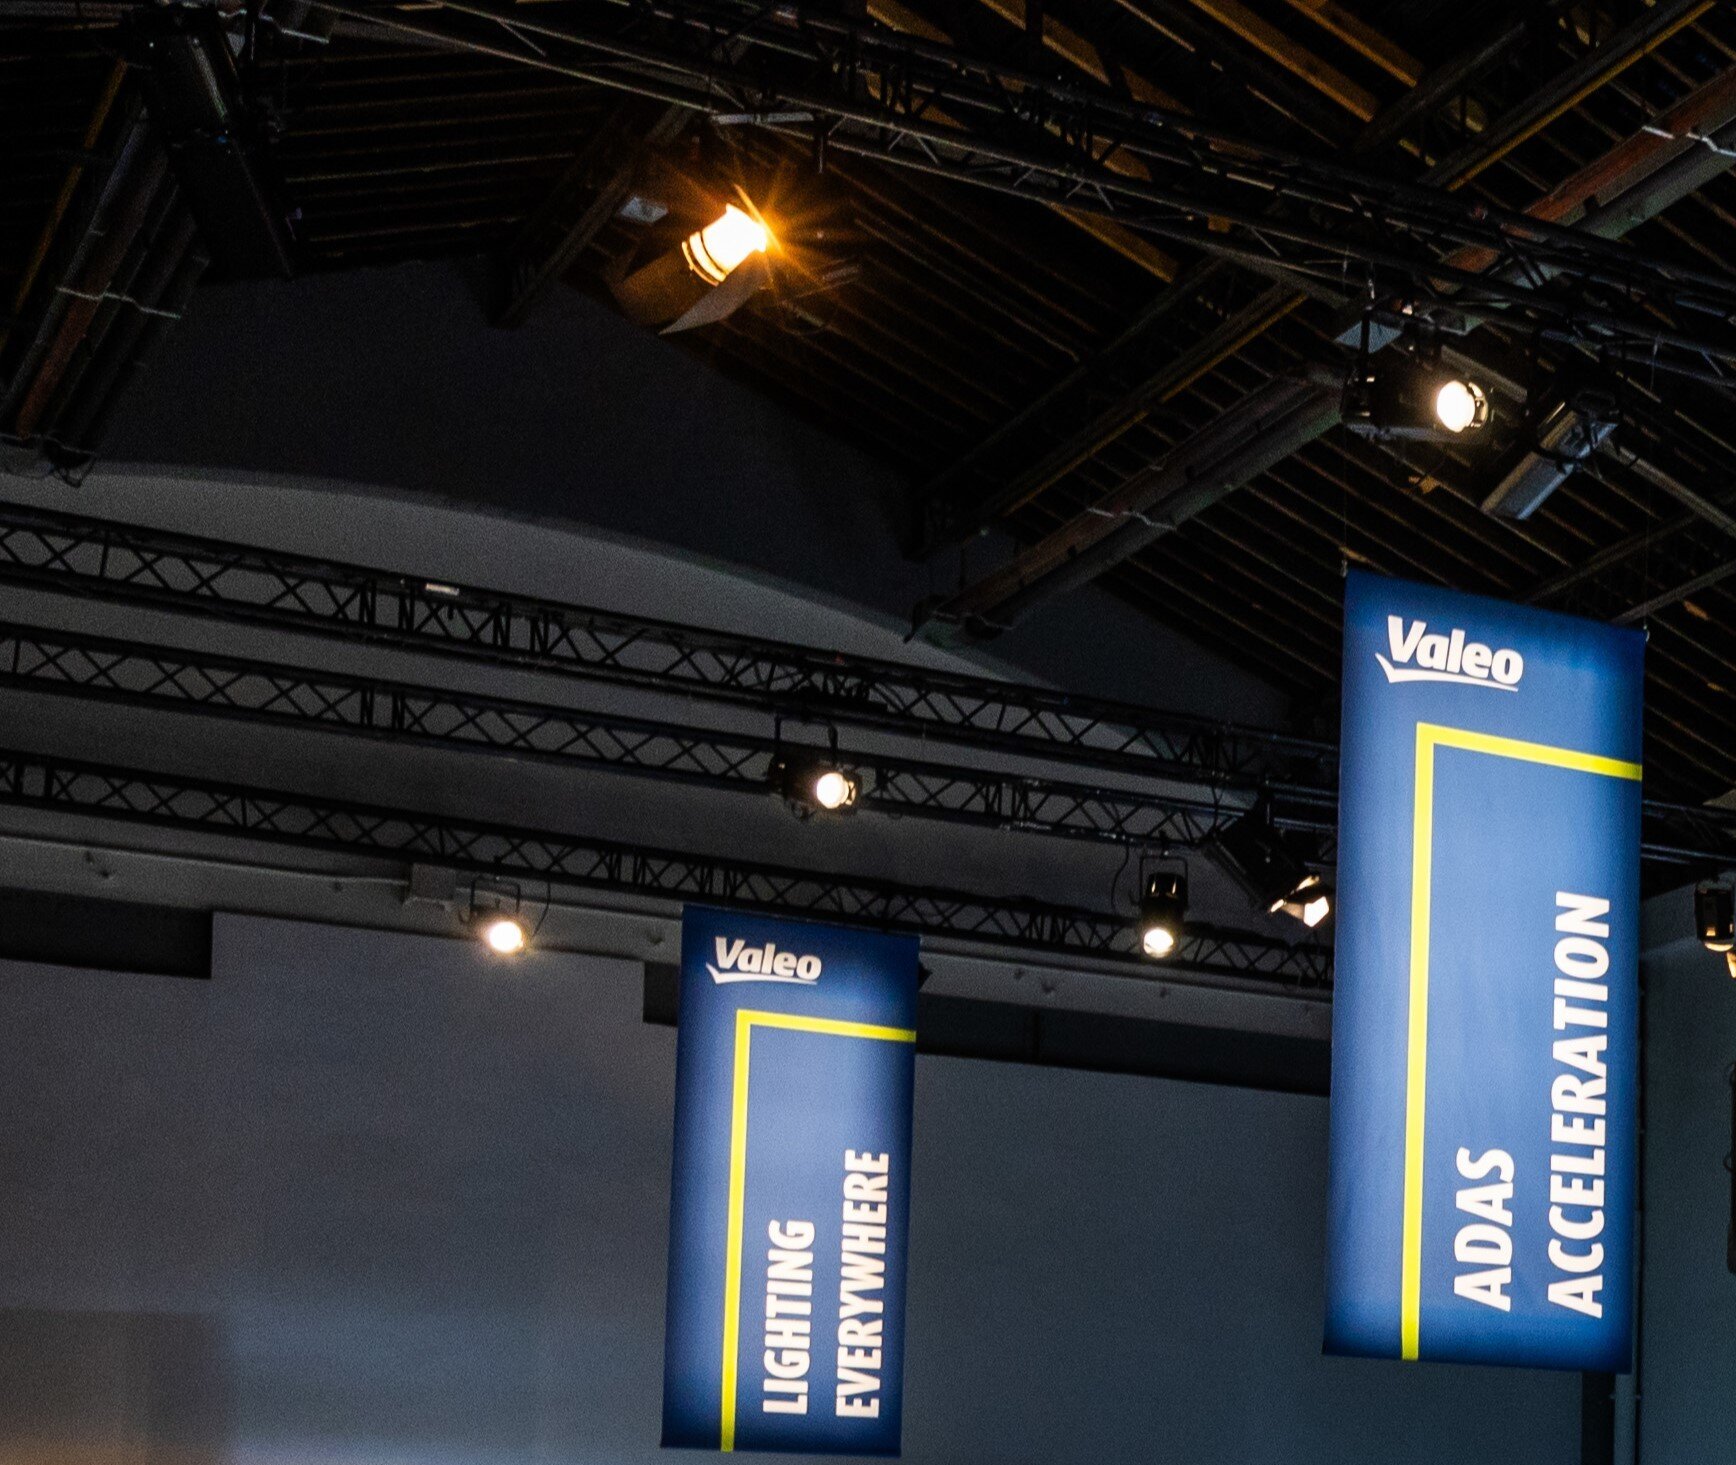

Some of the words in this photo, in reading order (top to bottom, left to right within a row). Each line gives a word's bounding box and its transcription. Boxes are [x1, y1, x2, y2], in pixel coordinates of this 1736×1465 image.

[1387, 614, 1524, 685] Valeo
[715, 936, 822, 980] Valeo
[1548, 890, 1610, 1320] ACCELERATION
[762, 1218, 816, 1416] LIGHTING
[834, 1148, 890, 1420] EVERYWHERE
[1453, 1145, 1516, 1313] ADAS
